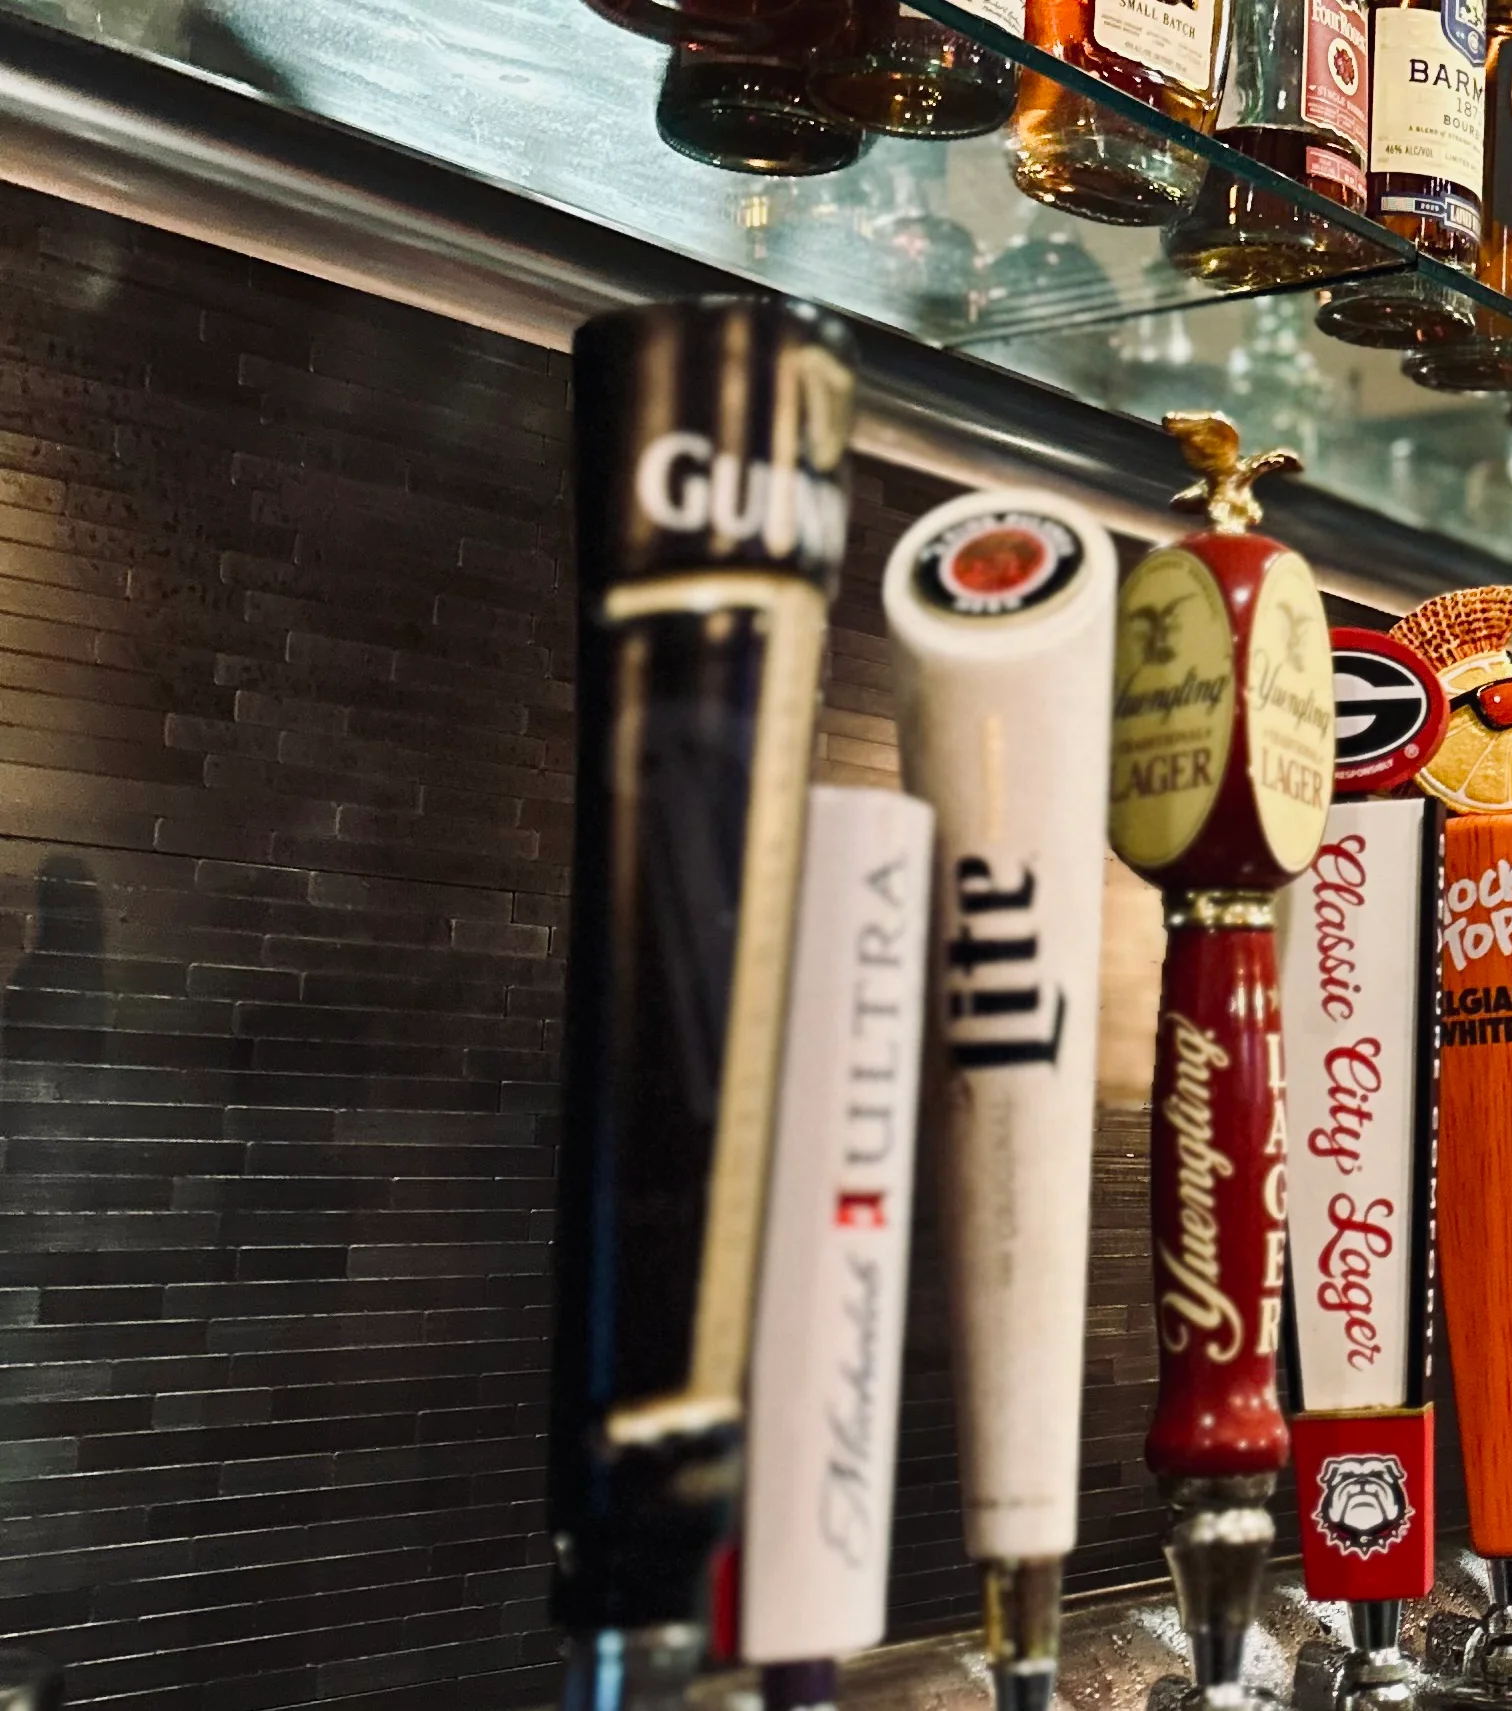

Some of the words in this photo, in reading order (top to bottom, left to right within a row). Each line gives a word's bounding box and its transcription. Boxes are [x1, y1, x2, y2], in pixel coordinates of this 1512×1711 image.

[1110, 0, 1158, 21] SMALL
[1162, 13, 1196, 39] BATCH
[1456, 97, 1479, 120] 187
[1260, 746, 1324, 811] LAGER
[843, 848, 908, 1170] ULTRA
[946, 853, 1068, 1071] Lite
[1312, 833, 1367, 1023] Classic
[1160, 1011, 1244, 1365] Yuengling
[1256, 1031, 1289, 1356] LAGER
[1307, 1036, 1383, 1177] City
[1316, 1192, 1395, 1371] Lager
